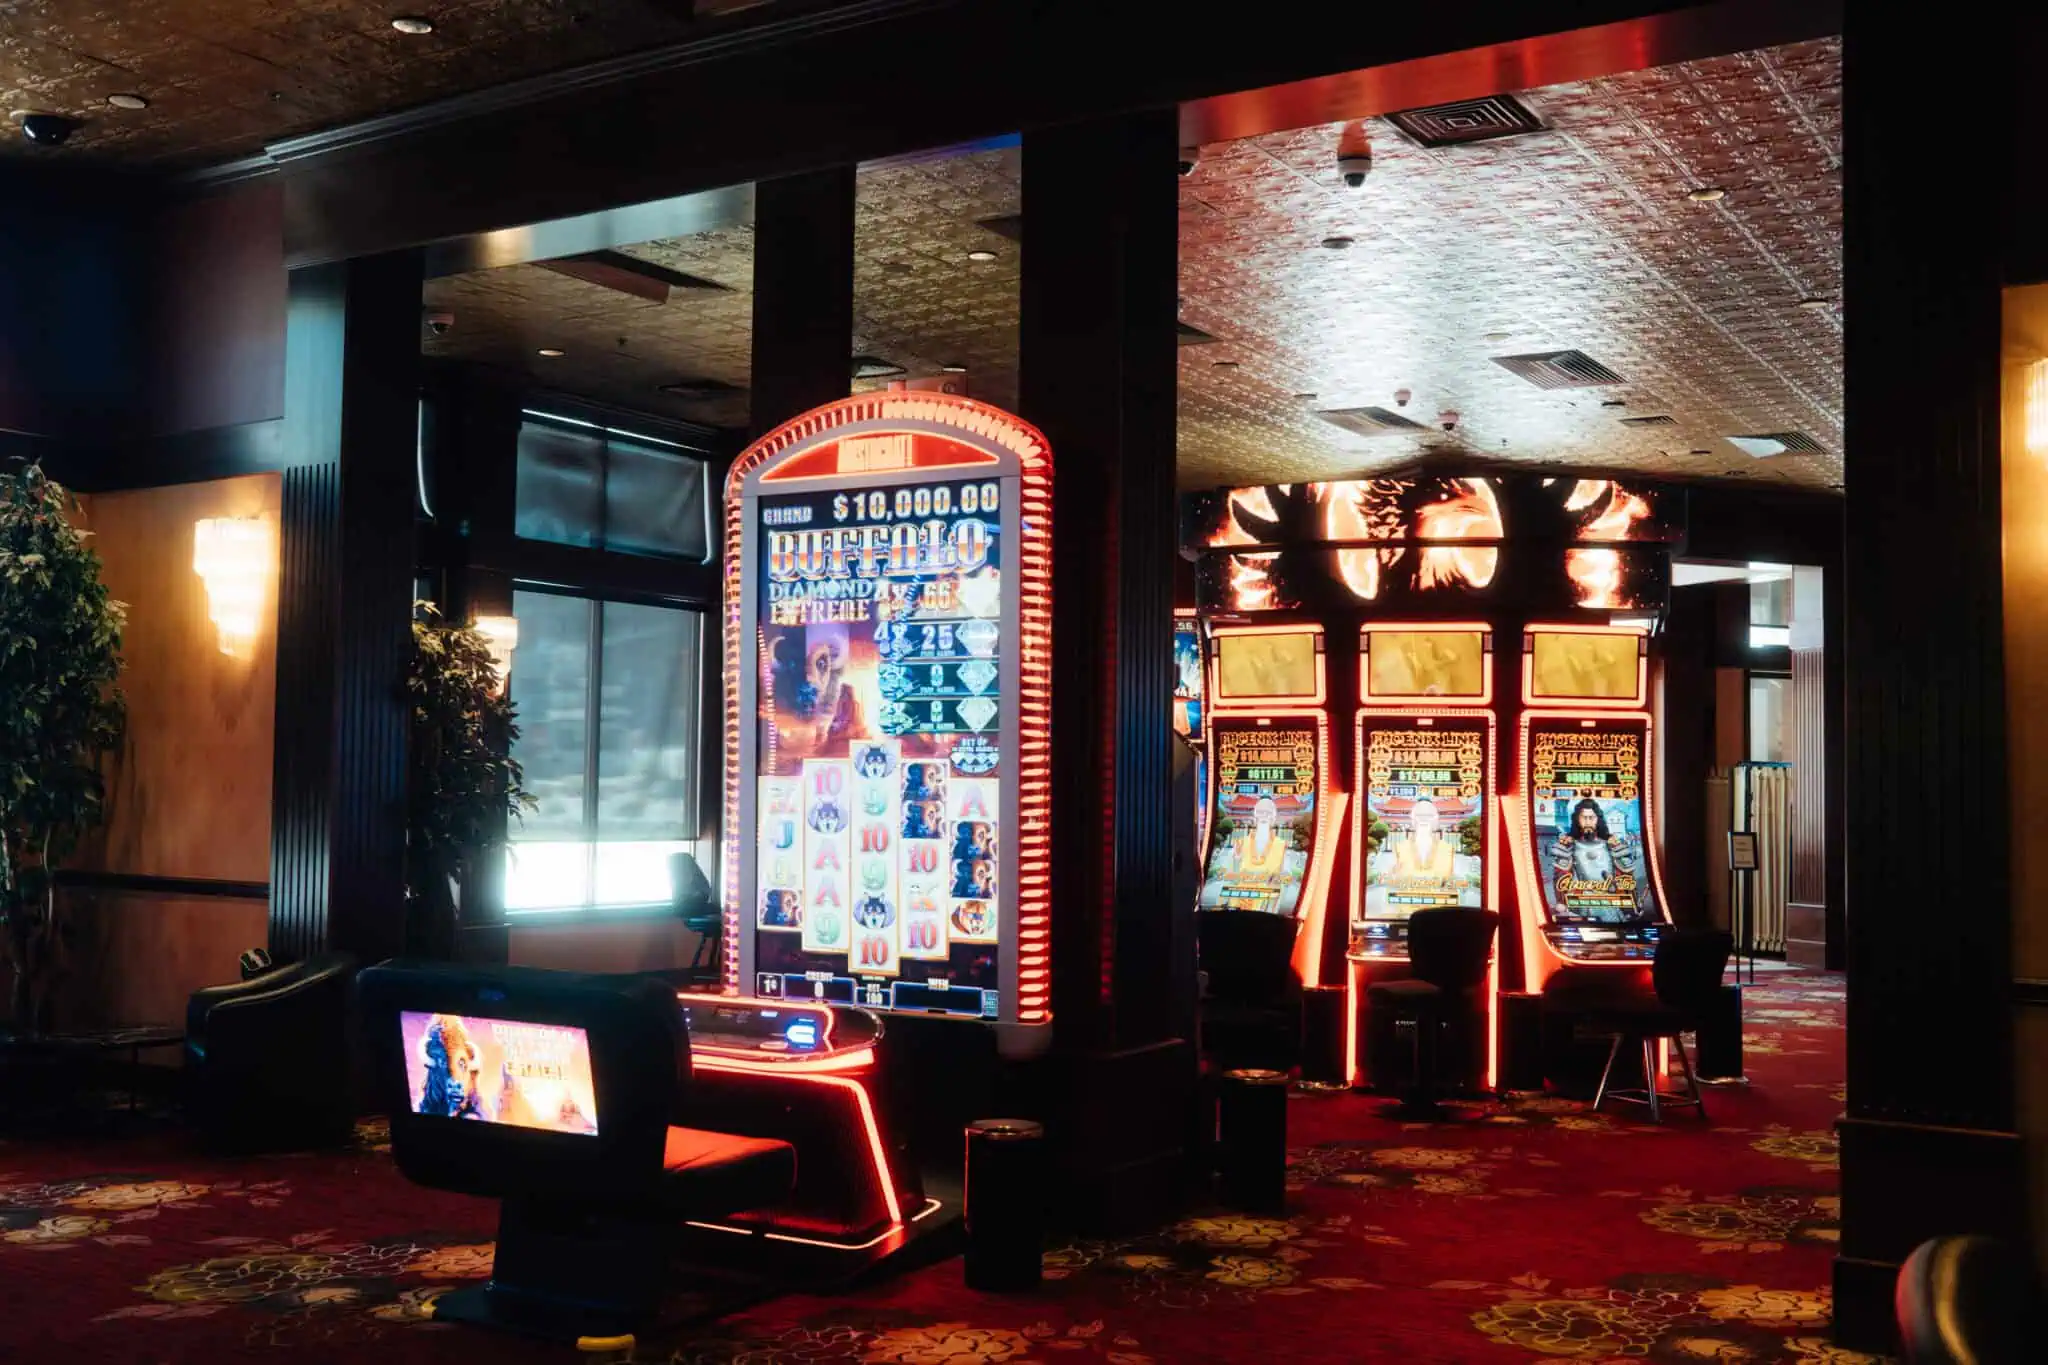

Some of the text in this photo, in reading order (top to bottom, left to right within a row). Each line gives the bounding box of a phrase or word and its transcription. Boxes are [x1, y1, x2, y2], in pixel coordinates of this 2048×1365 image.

[833, 483, 999, 521] $10,000.00
[768, 518, 993, 582] BUFFALO
[768, 577, 873, 600] DIAMOND
[921, 624, 953, 650] 25
[1536, 733, 1601, 748] PHOENIX
[814, 766, 843, 796] 10
[959, 784, 989, 817] A
[773, 819, 795, 850] J
[860, 822, 889, 853] 10
[813, 838, 841, 871] A
[908, 843, 938, 873] 10
[815, 875, 841, 907] A
[859, 933, 889, 966] 10
[907, 919, 938, 950] 10
[814, 981, 824, 998] 0
